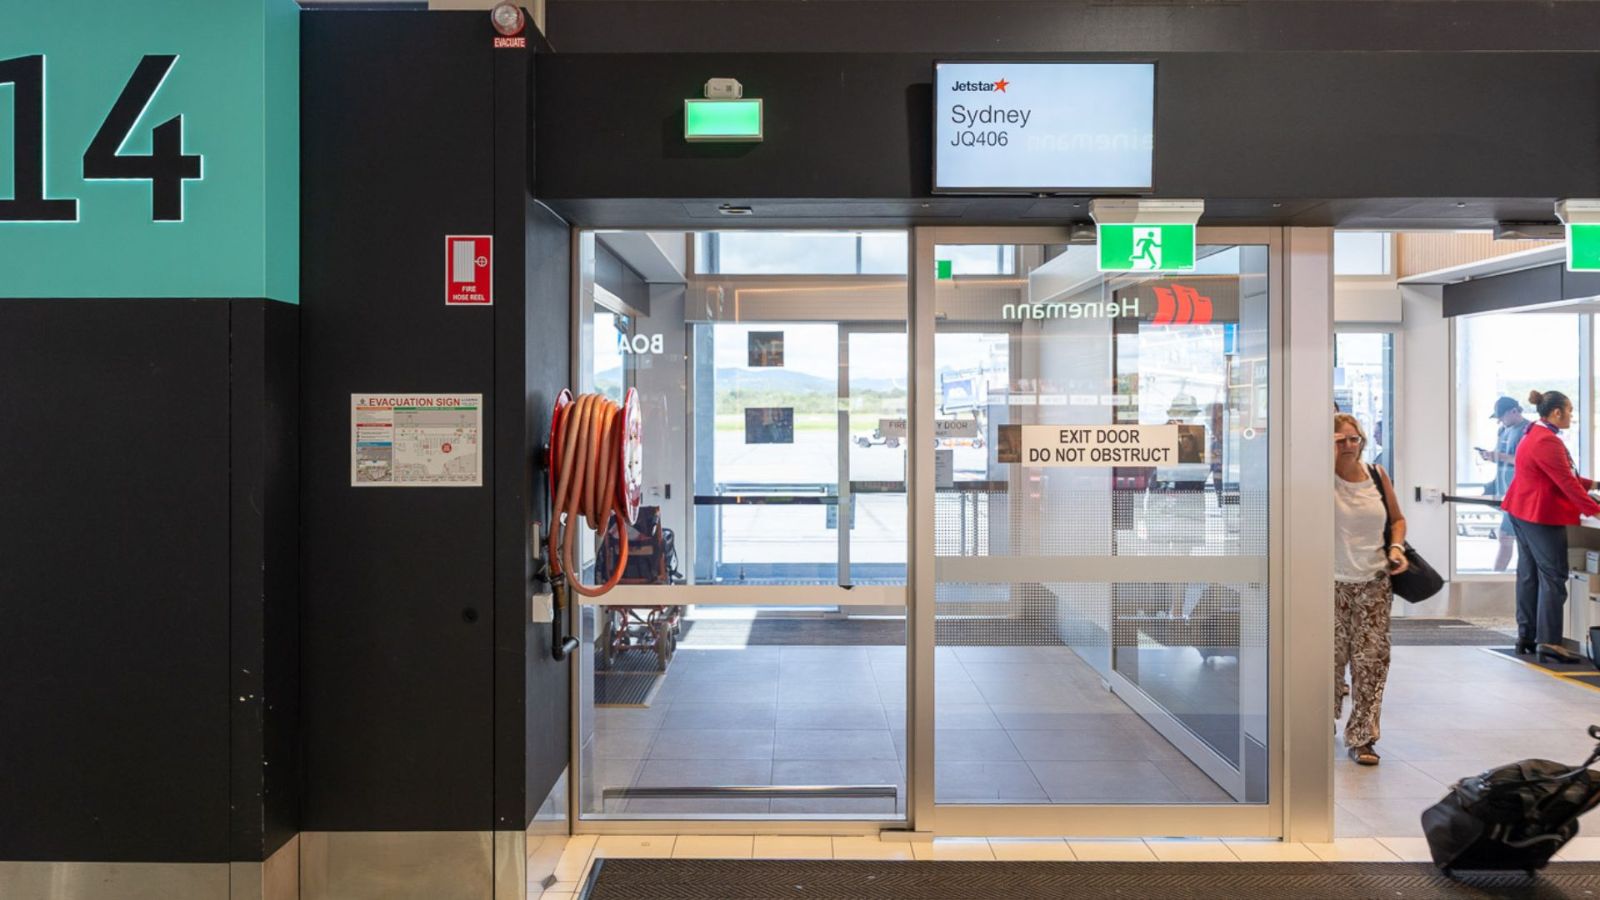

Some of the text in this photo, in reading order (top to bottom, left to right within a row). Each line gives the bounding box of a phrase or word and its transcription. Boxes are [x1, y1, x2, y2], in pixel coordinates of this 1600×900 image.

[494, 37, 526, 48] EVACUATE
[952, 80, 995, 92] Jetstar
[951, 104, 1031, 128] Sydney
[0, 54, 204, 222] 14
[950, 131, 1009, 147] JQ406
[462, 285, 476, 293] FIRE
[368, 397, 433, 407] EVACUATION
[436, 397, 461, 407] SIGN
[944, 421, 968, 429] DOOR
[1059, 429, 1140, 444] EXIT DOOR
[1029, 447, 1171, 462] DO NOT OBSTRUCT
